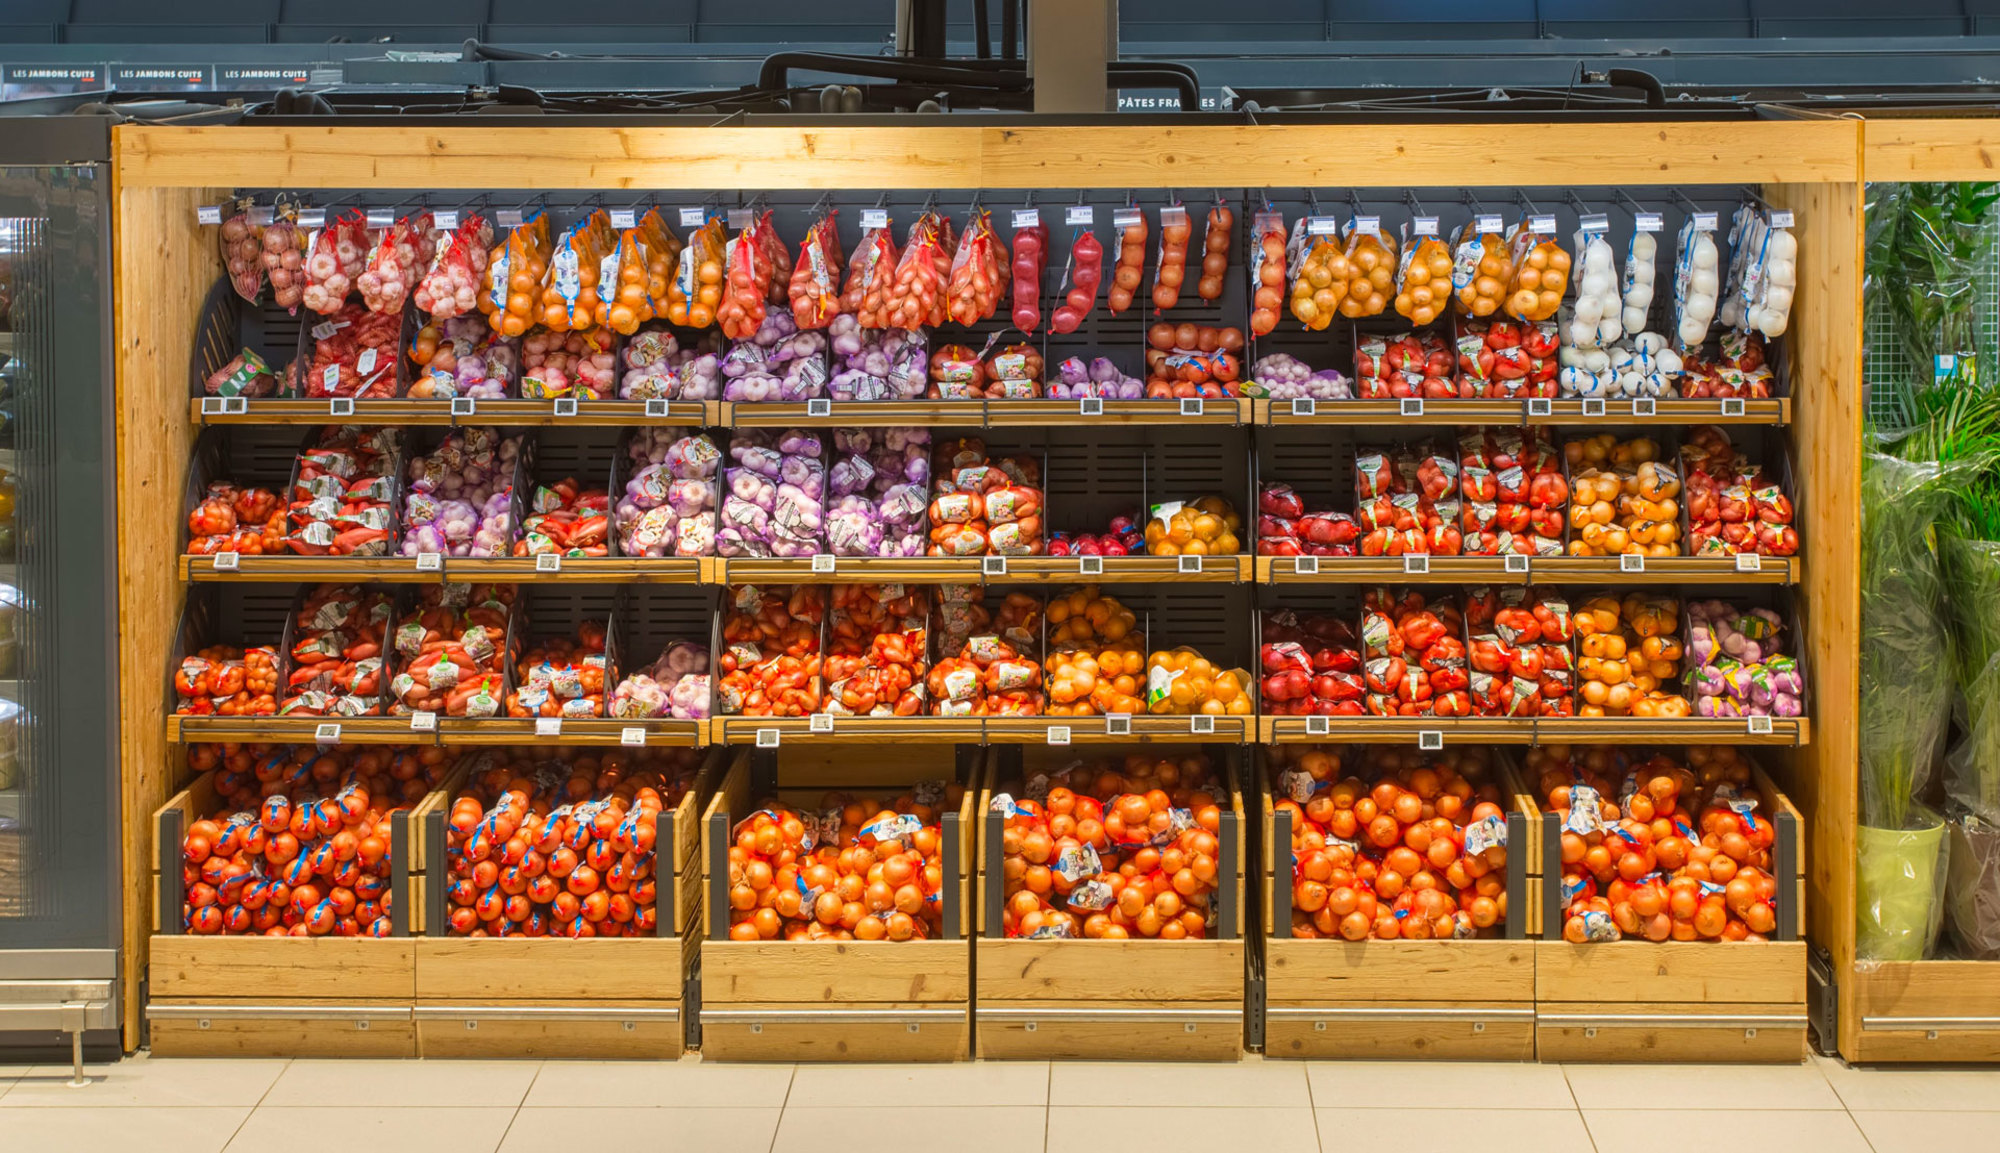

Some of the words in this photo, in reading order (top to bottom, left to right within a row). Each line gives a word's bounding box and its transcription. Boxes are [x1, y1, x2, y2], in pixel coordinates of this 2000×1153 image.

[12, 70, 27, 78] LES
[28, 70, 69, 78] JAMBONS
[70, 70, 95, 78] CUITS
[120, 70, 134, 78] LES
[135, 70, 176, 78] JAMBONS
[177, 70, 202, 78] CUITS
[225, 70, 239, 78] LES
[241, 70, 280, 78] JAMBONS
[282, 70, 307, 78] CUITS
[1119, 97, 1155, 107] PÂTES
[1158, 98, 1215, 107] FRAES
